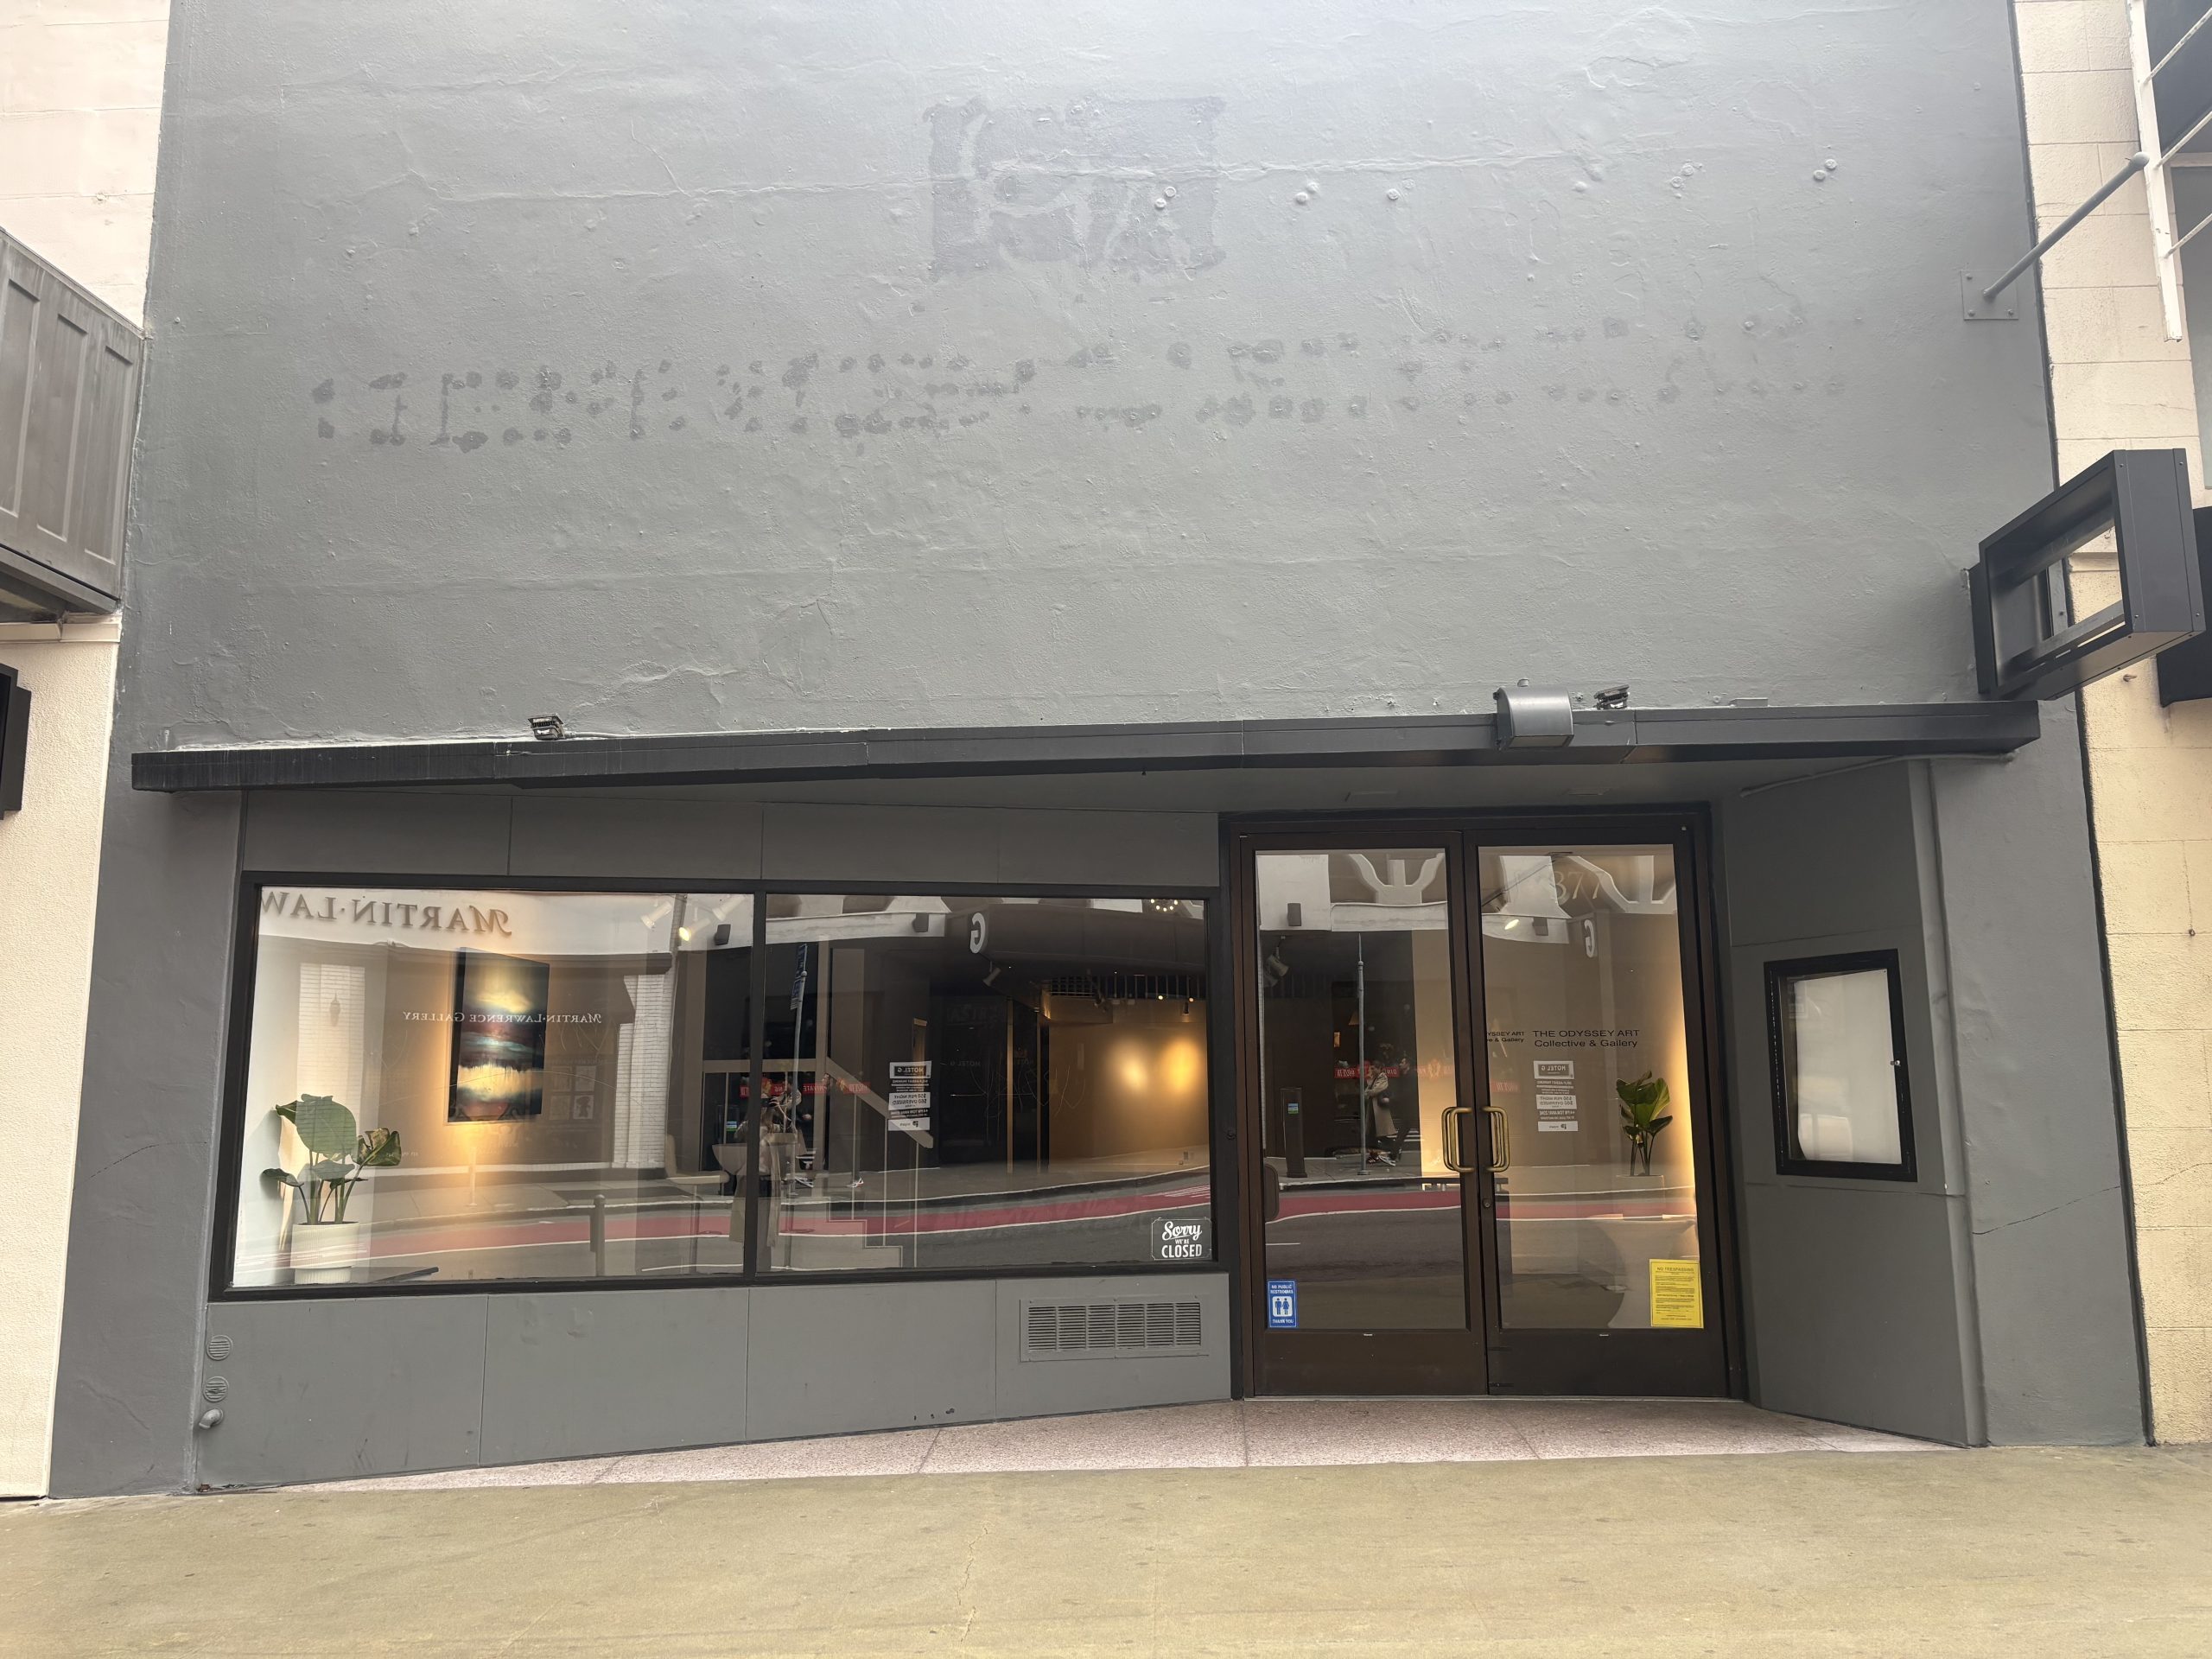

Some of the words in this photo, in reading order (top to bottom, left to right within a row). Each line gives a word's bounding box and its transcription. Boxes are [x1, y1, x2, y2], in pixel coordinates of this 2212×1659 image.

[1600, 1039, 1638, 1048] Gallery
[1162, 1221, 1202, 1241] Sorry
[1161, 1244, 1202, 1258] CLOSED
